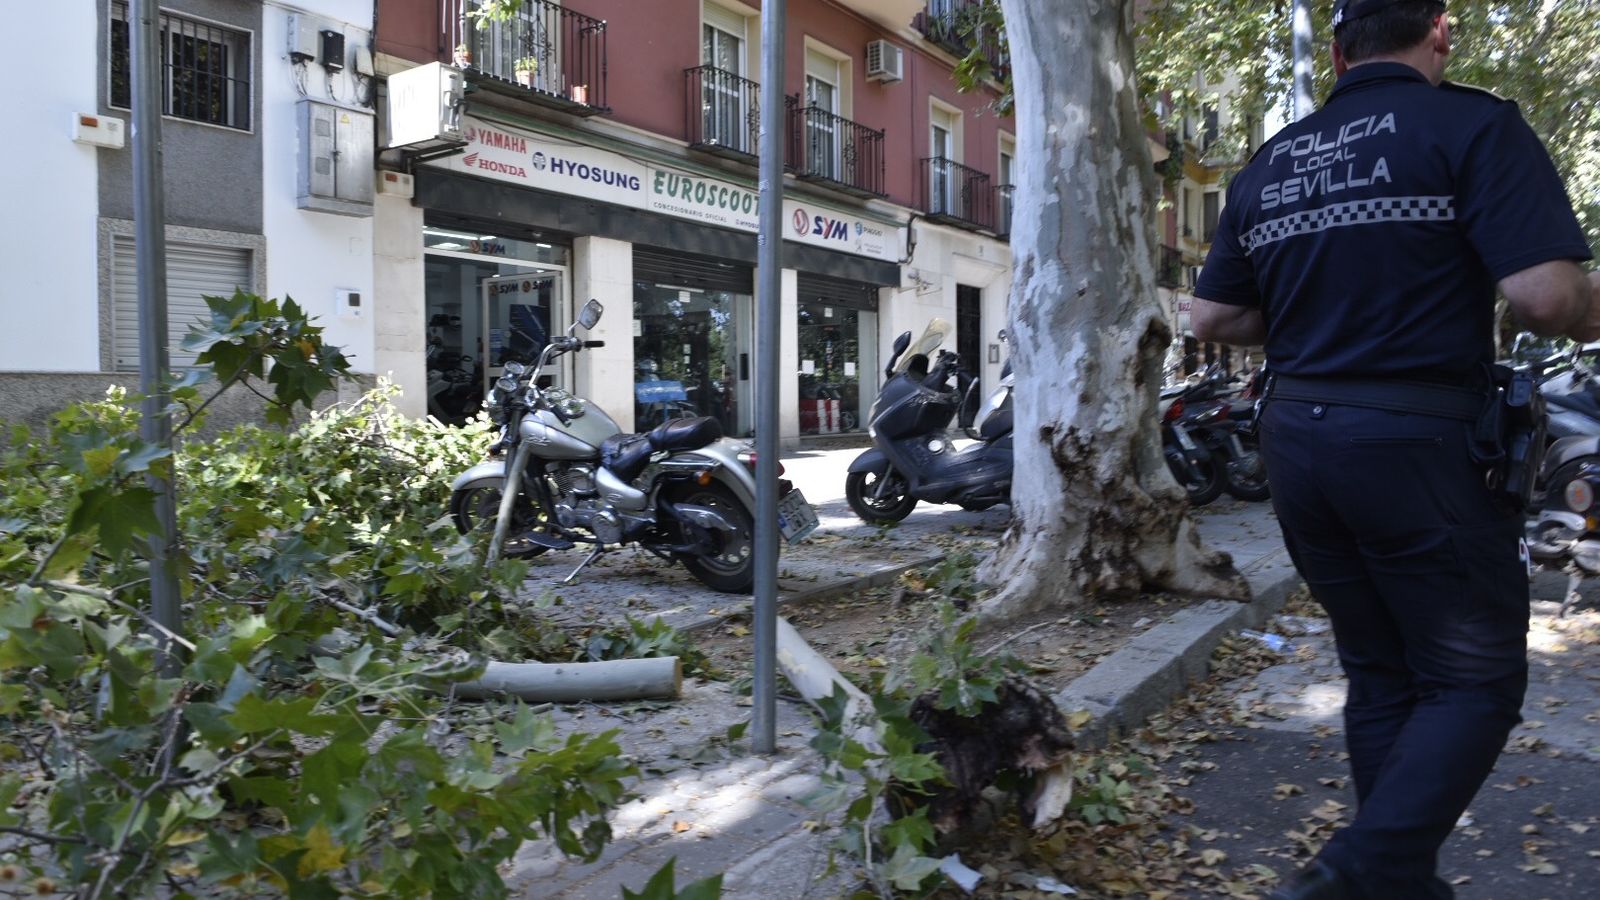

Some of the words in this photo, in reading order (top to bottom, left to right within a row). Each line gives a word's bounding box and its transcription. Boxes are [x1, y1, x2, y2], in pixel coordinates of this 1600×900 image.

[479, 128, 527, 154] YAMAHA
[1269, 112, 1396, 166] POLICIA
[479, 158, 527, 178] HONDA
[1294, 147, 1356, 174] LOCAL
[551, 157, 640, 191] HYOSUNG
[1261, 156, 1392, 210] SEVILLA
[812, 215, 848, 241] SYM
[483, 242, 505, 255] SYM
[499, 283, 519, 295] SYM
